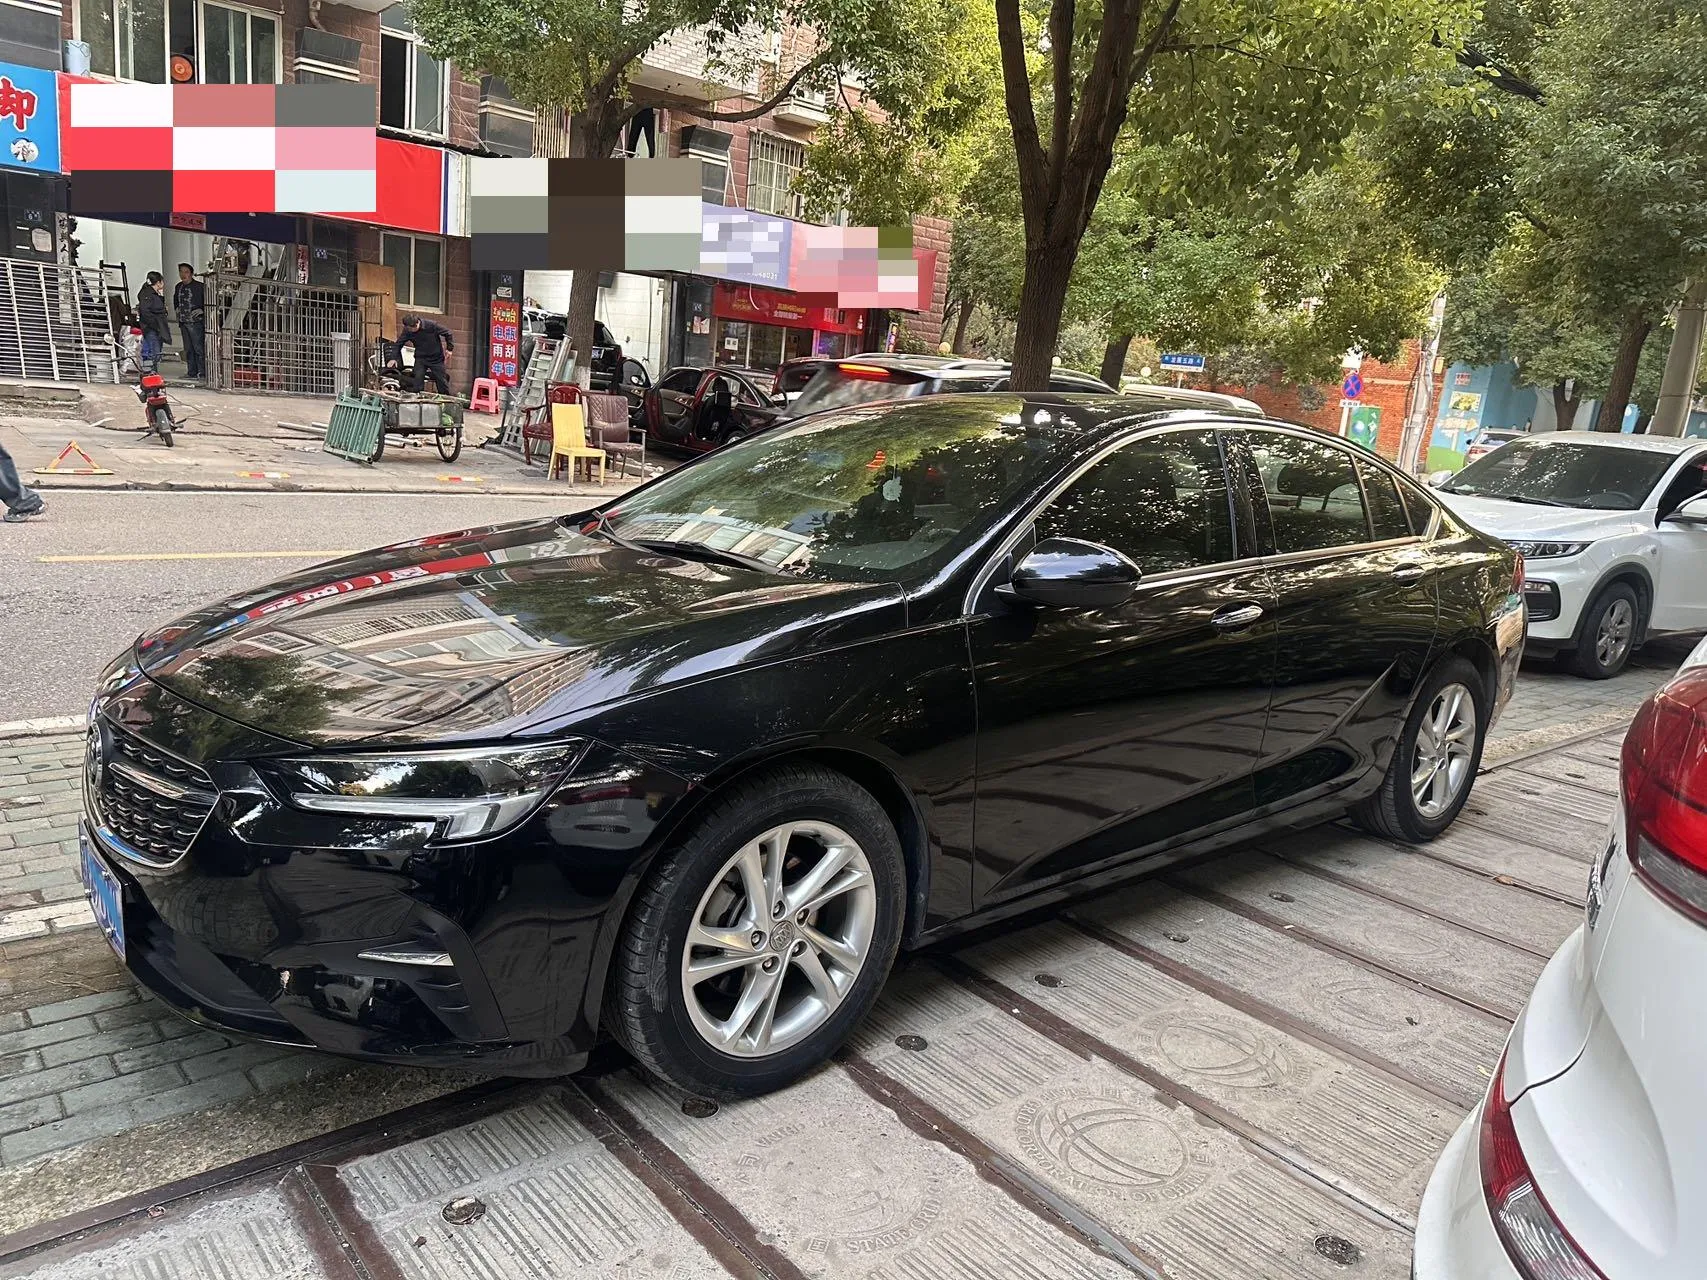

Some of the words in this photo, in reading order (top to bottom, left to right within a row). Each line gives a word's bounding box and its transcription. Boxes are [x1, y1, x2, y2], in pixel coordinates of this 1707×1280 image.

[492, 325, 517, 342] 电瓶
[492, 343, 516, 359] 雨刮
[491, 360, 516, 377] 年审
[845, 1228, 912, 1254] STATE
